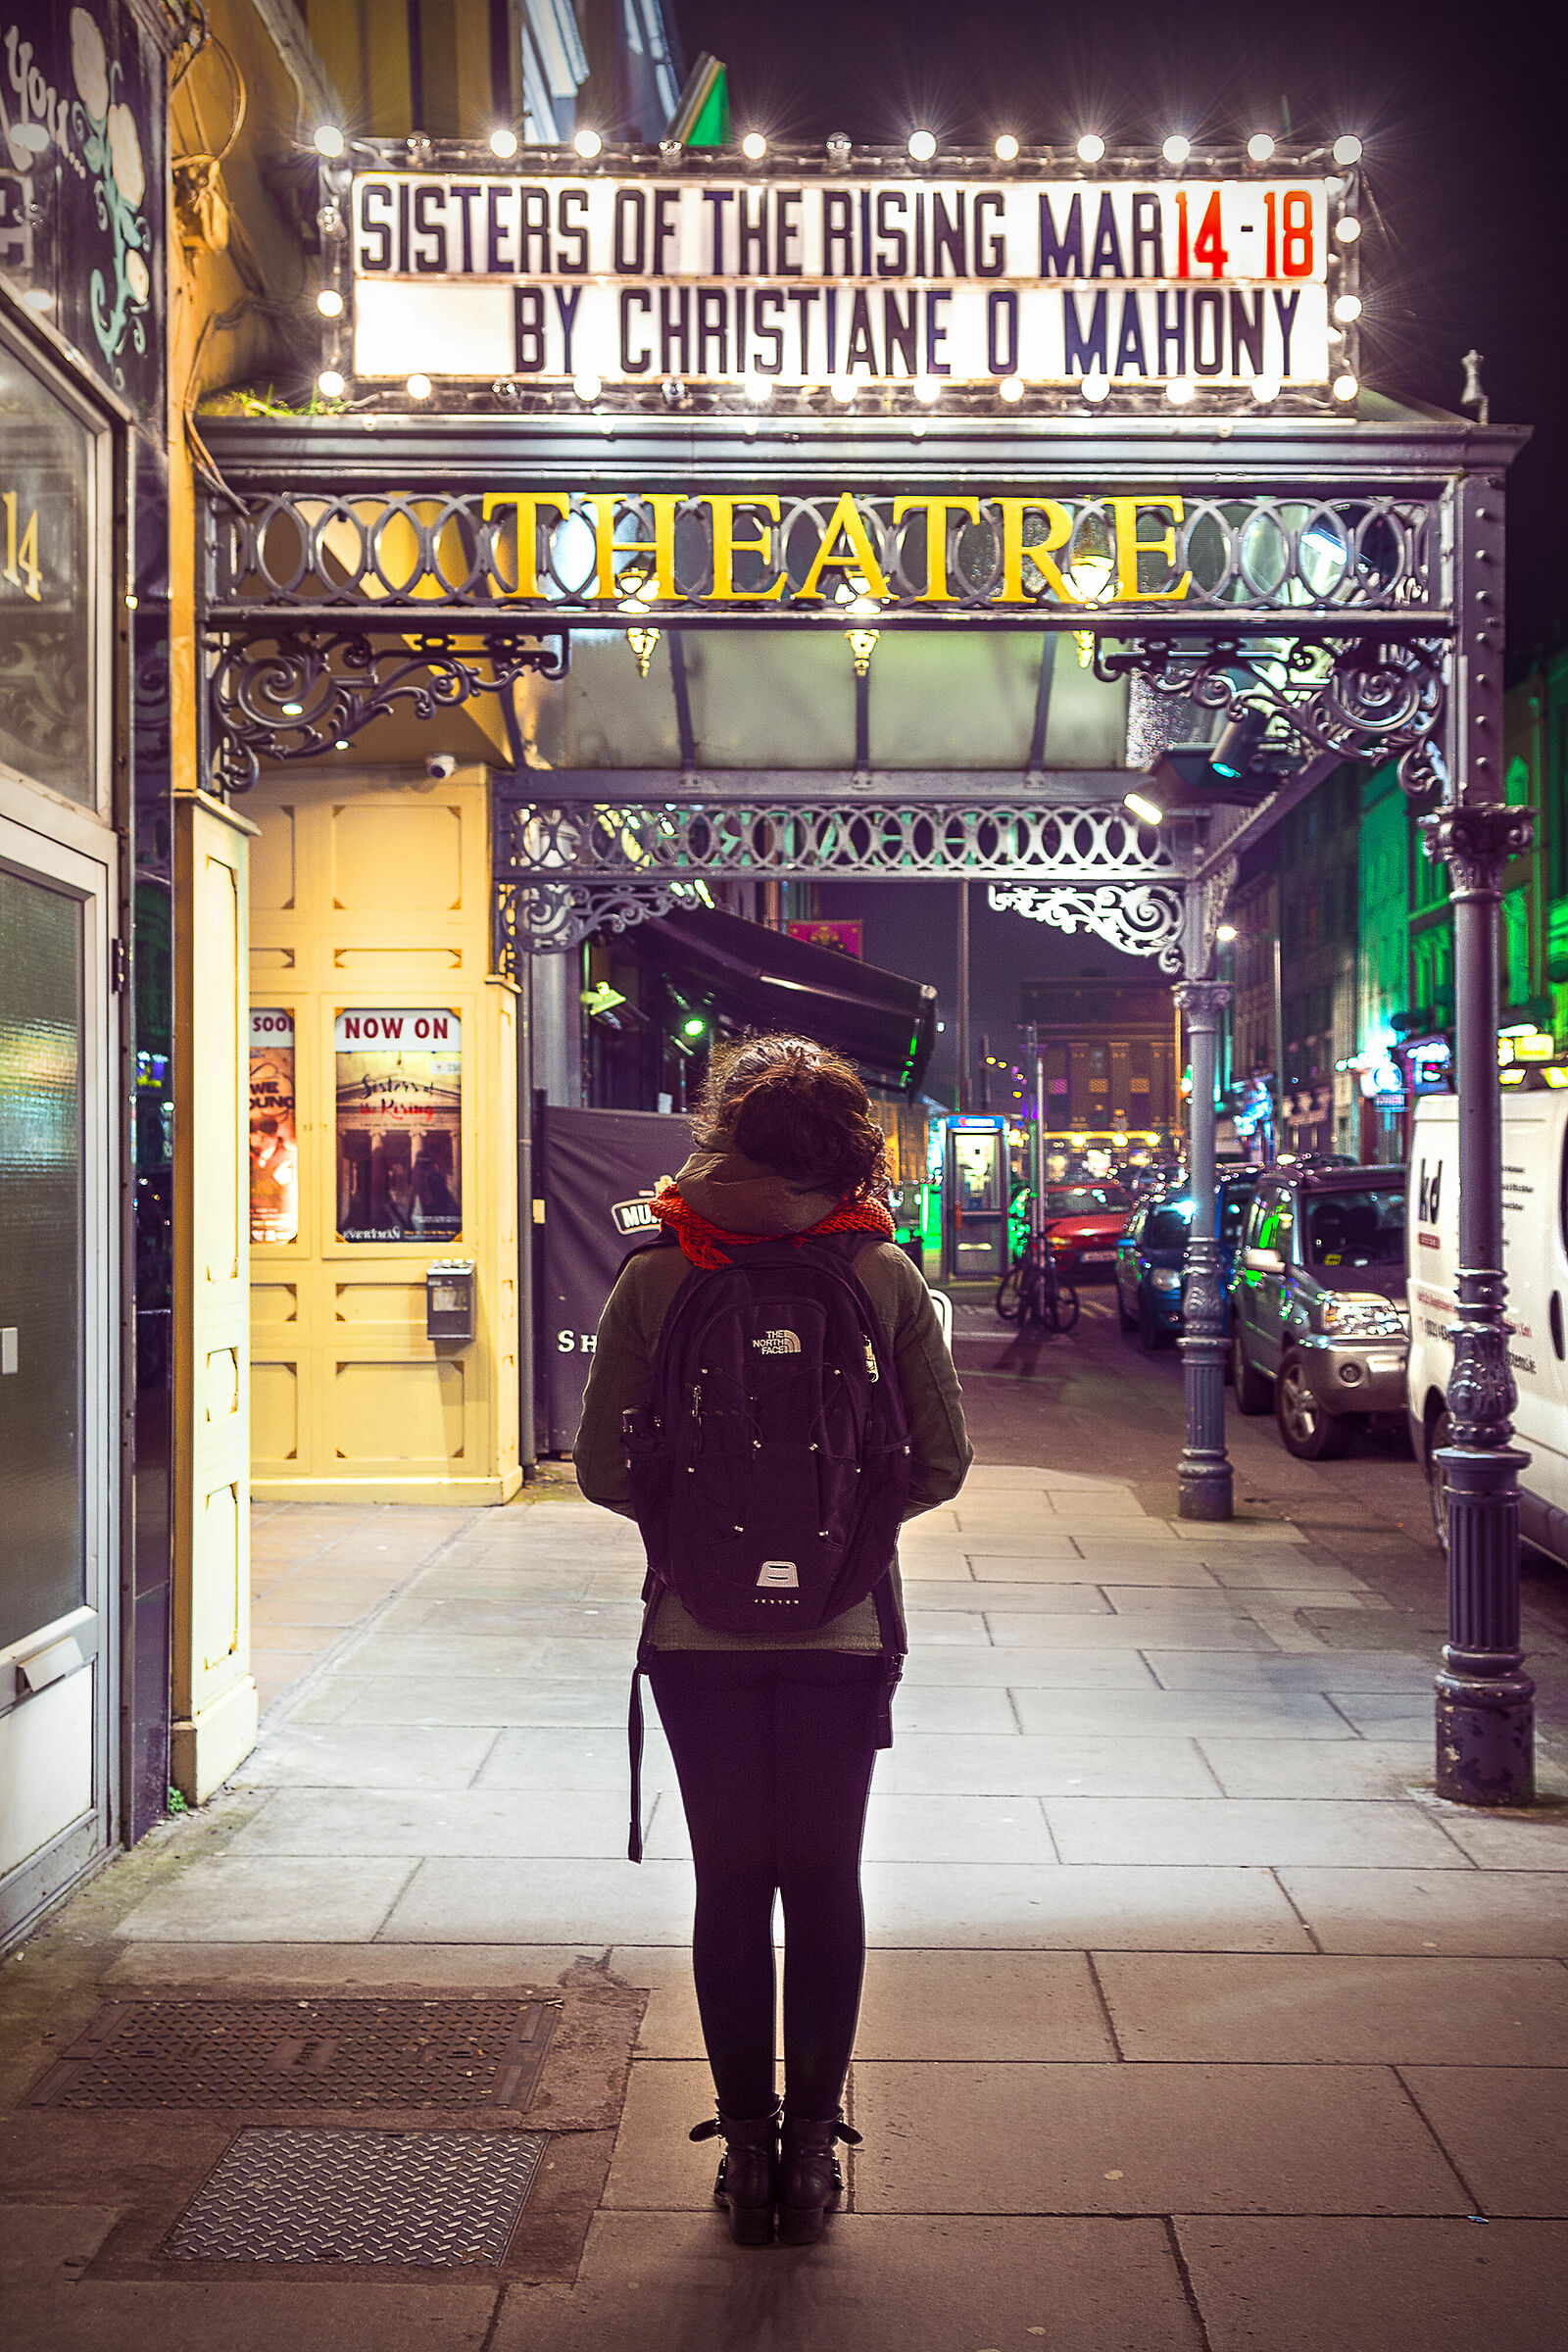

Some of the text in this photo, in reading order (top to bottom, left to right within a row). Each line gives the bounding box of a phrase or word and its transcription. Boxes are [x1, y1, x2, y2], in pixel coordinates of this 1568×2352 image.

[360, 184, 589, 274] SISTERS
[614, 187, 681, 275] OF
[702, 188, 804, 276] THE
[823, 189, 1006, 277] RISING
[1038, 190, 1164, 278] MAR
[514, 286, 1300, 376] BY CHRISTIANE O MAHONY
[2, 491, 42, 602] 14
[482, 491, 1193, 604] THEATRE
[345, 1017, 449, 1039] NOW ON
[753, 1338, 784, 1348] NORTH
[761, 1346, 784, 1354] FACE
